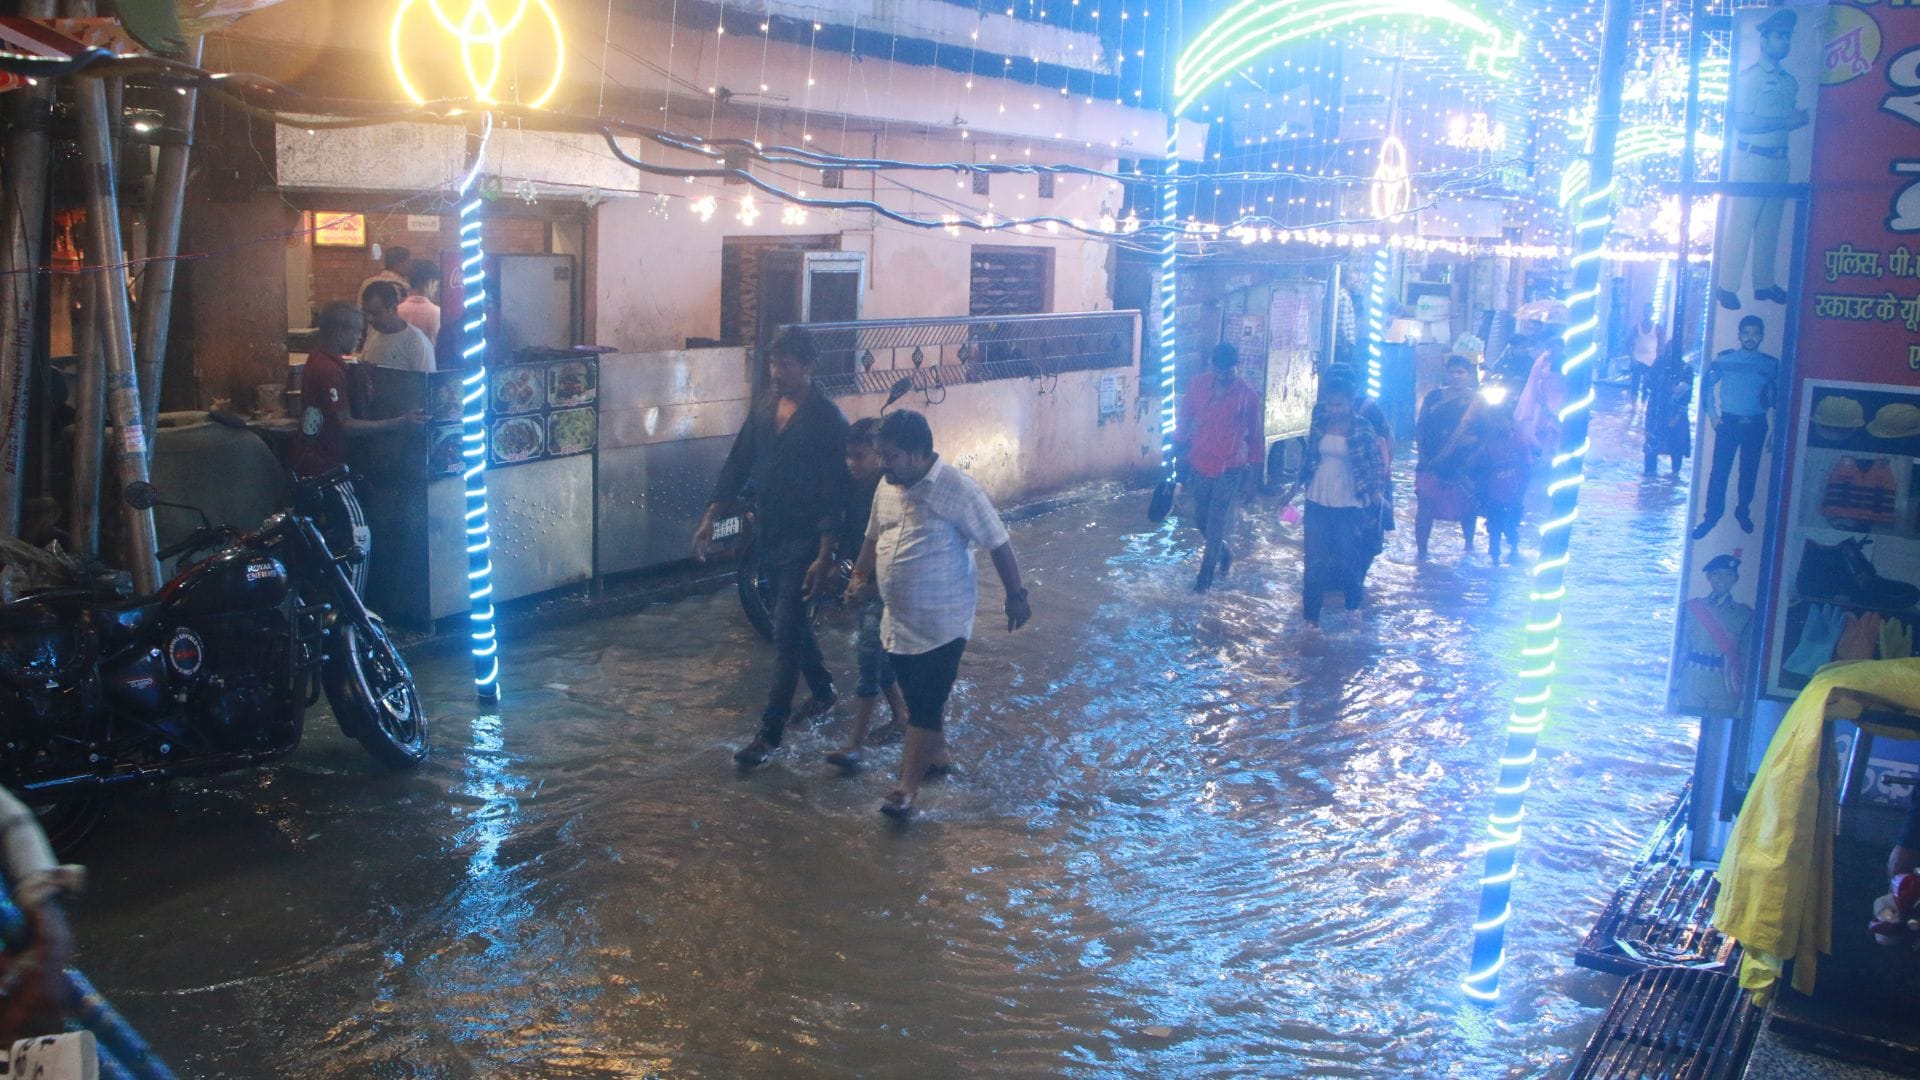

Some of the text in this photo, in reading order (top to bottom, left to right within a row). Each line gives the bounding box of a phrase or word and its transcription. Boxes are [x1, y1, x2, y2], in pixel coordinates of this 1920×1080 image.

[329, 387, 339, 402] 3
[247, 563, 273, 573] ROYAL
[246, 569, 277, 581] ENFIELD
